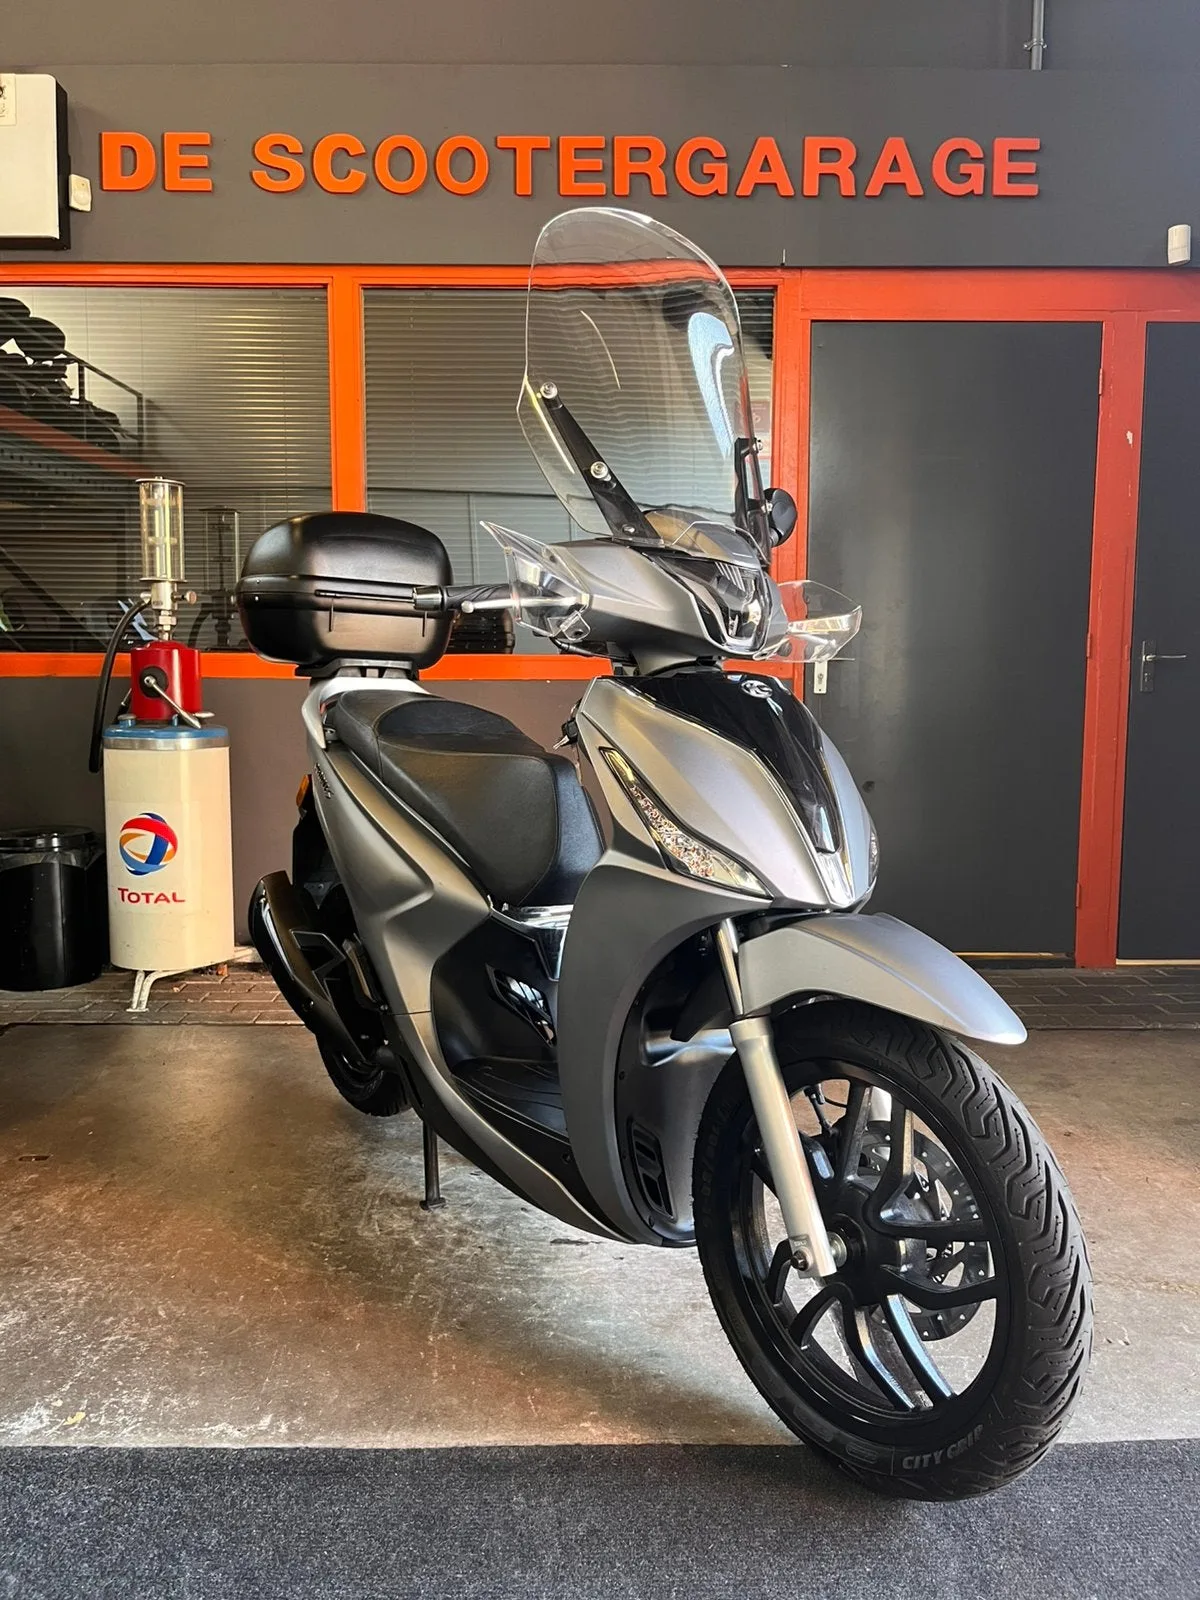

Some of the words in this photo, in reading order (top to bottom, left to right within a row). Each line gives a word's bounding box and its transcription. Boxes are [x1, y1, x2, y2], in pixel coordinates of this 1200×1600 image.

[100, 131, 213, 192] DE
[251, 132, 1041, 197] SCOOTERGARAGE
[117, 887, 186, 904] TOTAL
[902, 1449, 944, 1470] CITY
[946, 1423, 984, 1459] GRIP
